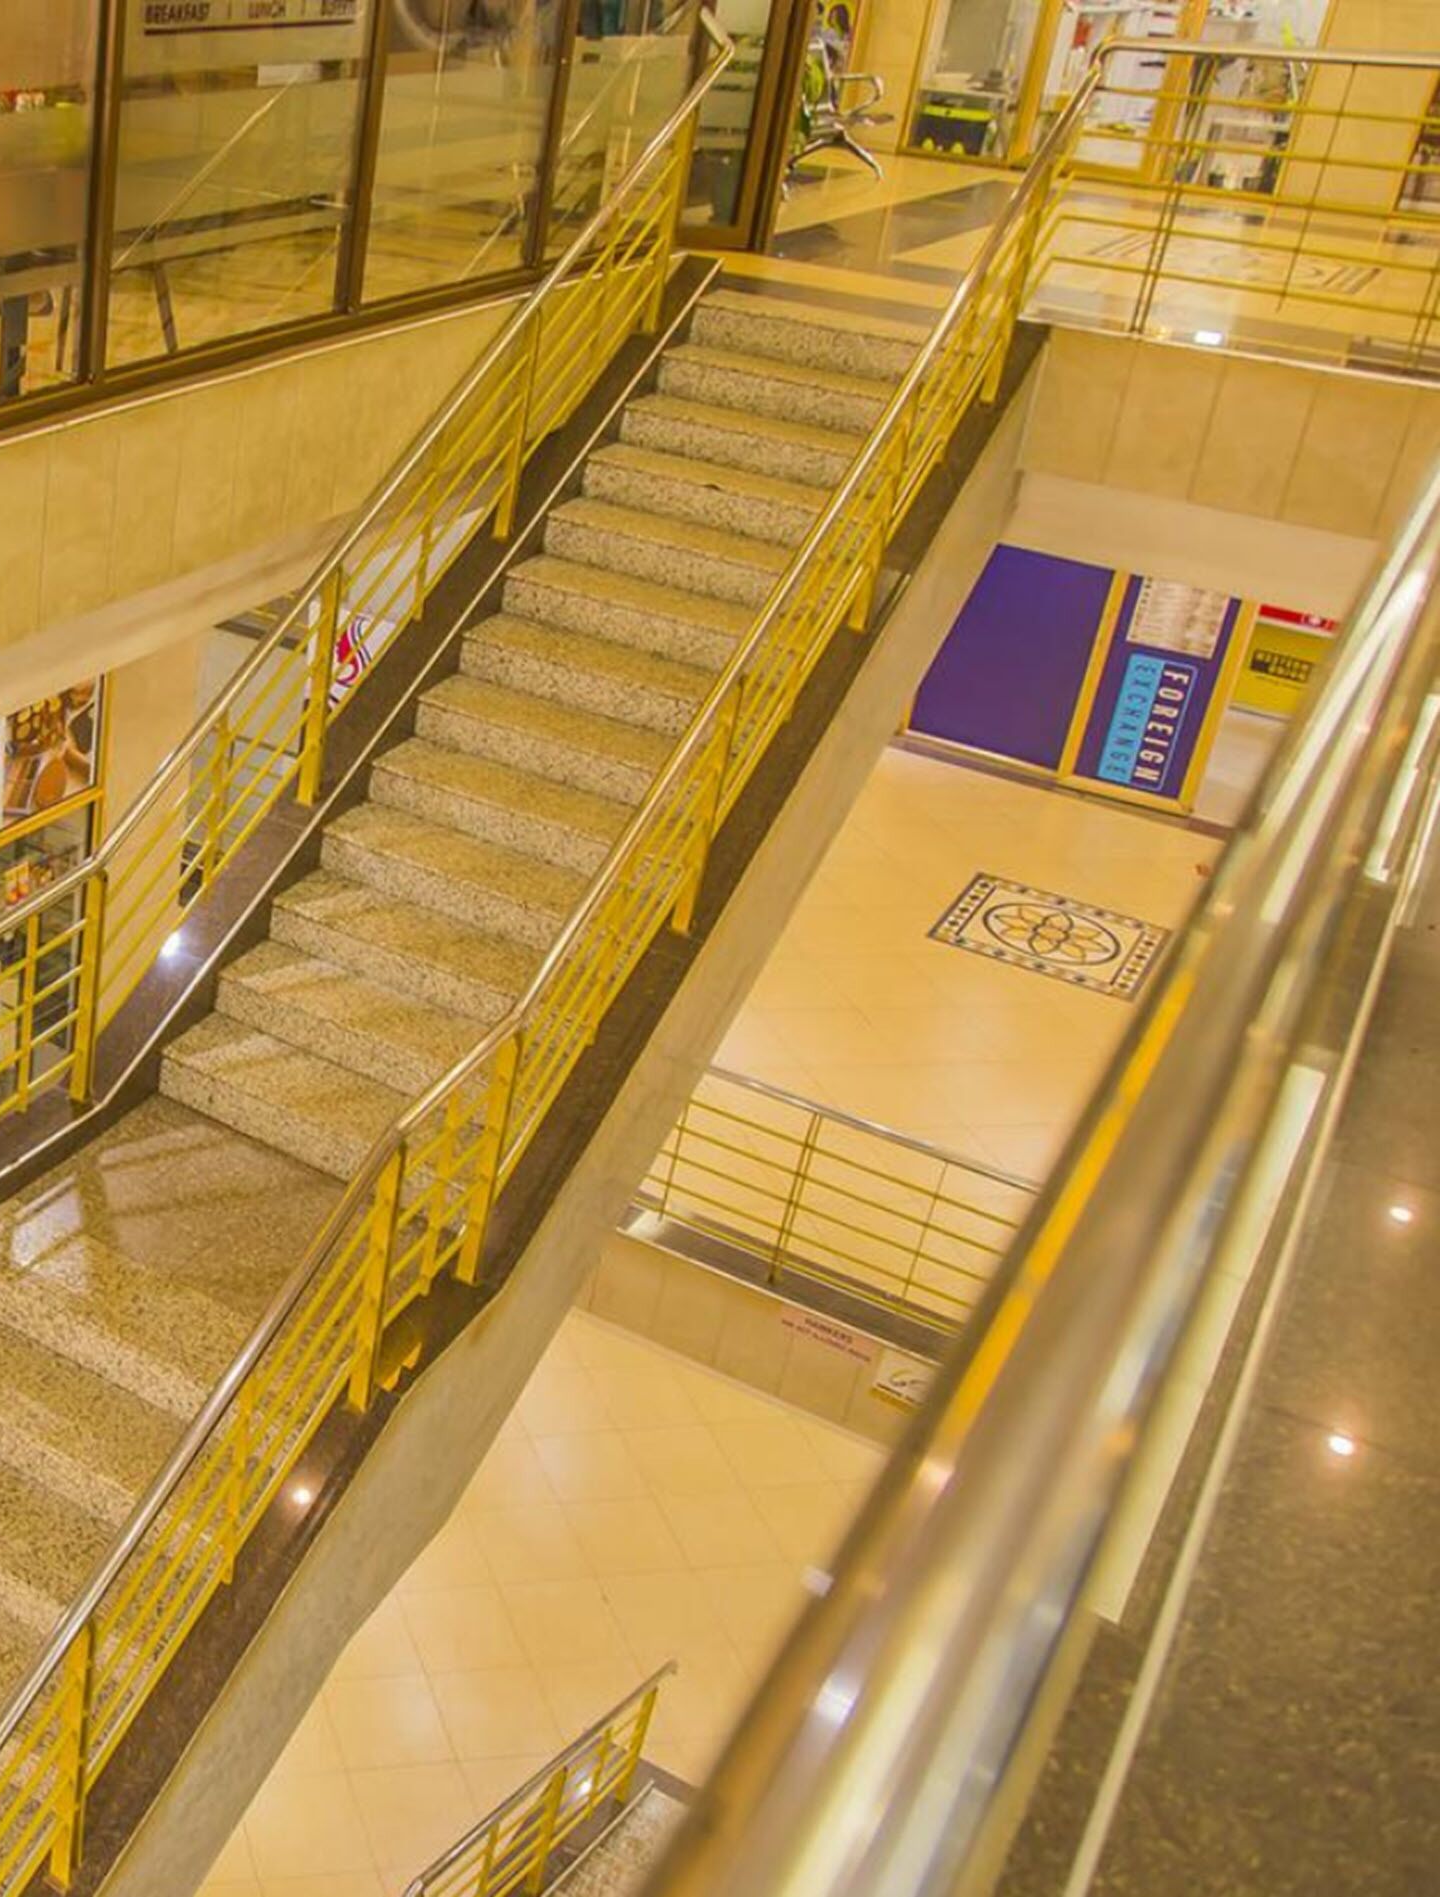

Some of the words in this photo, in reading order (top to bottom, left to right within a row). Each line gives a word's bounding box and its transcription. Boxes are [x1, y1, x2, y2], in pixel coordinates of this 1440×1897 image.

[144, 3, 210, 23] BREAKFAST
[1106, 662, 1157, 776] EXCHANGE
[1134, 669, 1190, 781] FOREIGN
